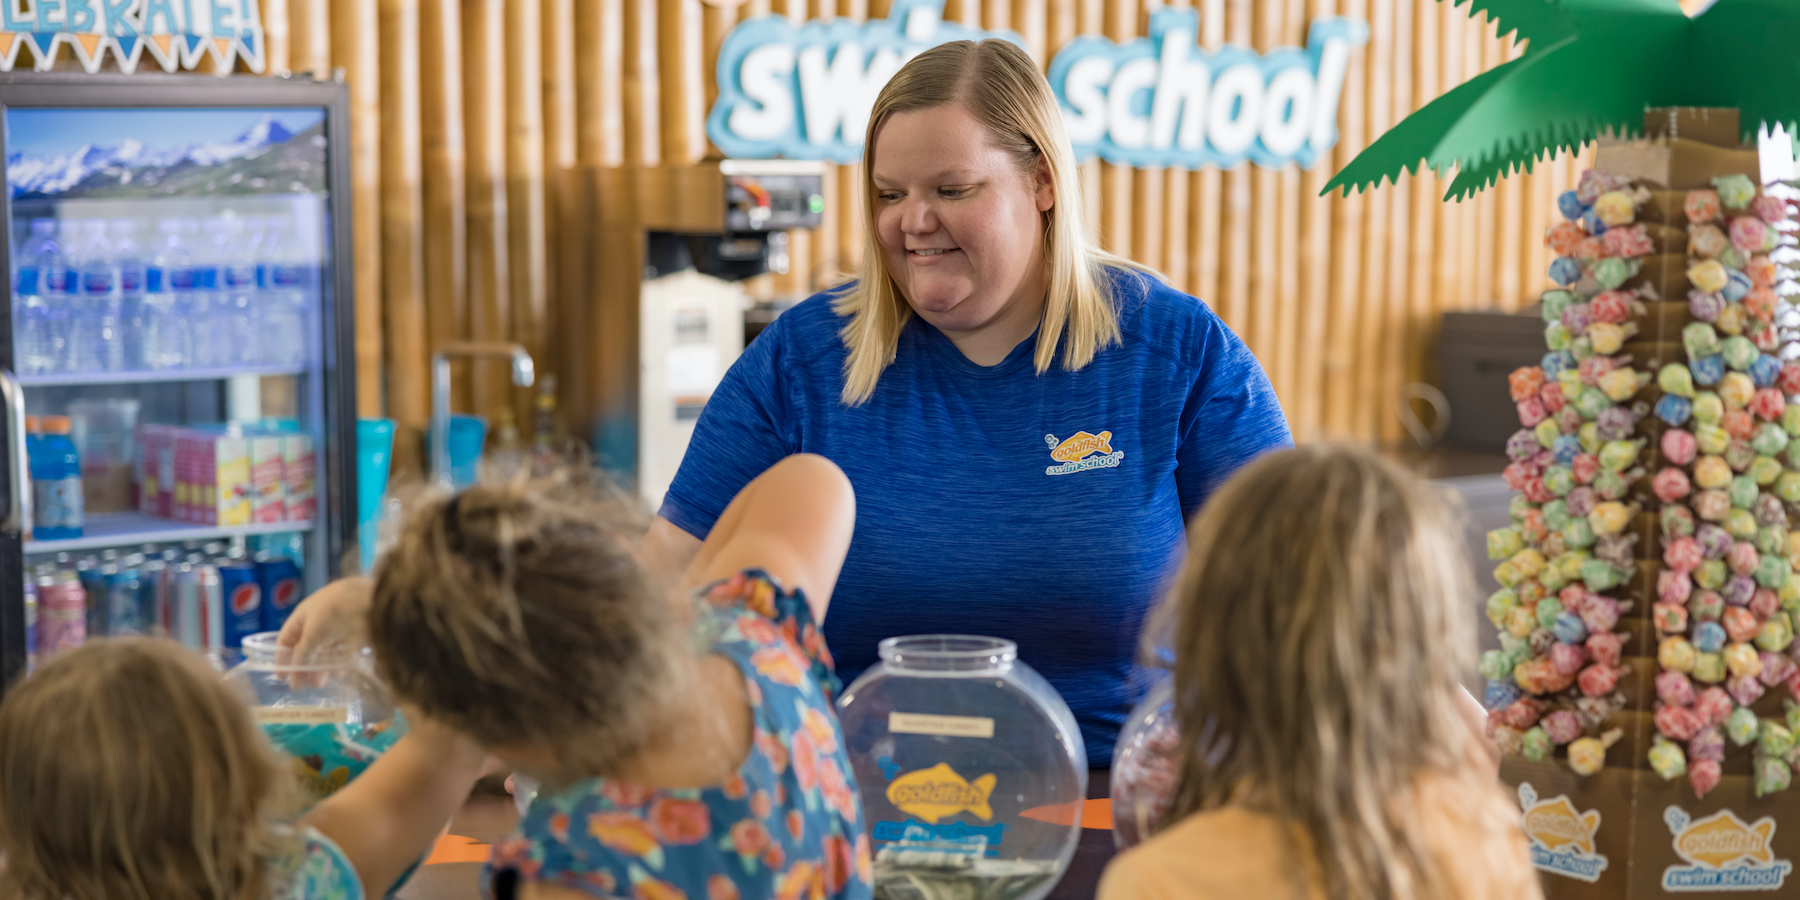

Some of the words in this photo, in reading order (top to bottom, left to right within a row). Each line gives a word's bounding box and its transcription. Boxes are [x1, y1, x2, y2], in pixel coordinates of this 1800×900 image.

[728, 5, 938, 146] sw
[1065, 28, 1350, 156] school
[1056, 436, 1105, 460] goldfish
[1047, 462, 1079, 475] swim
[1080, 454, 1119, 470] school
[1719, 866, 1782, 886] school
